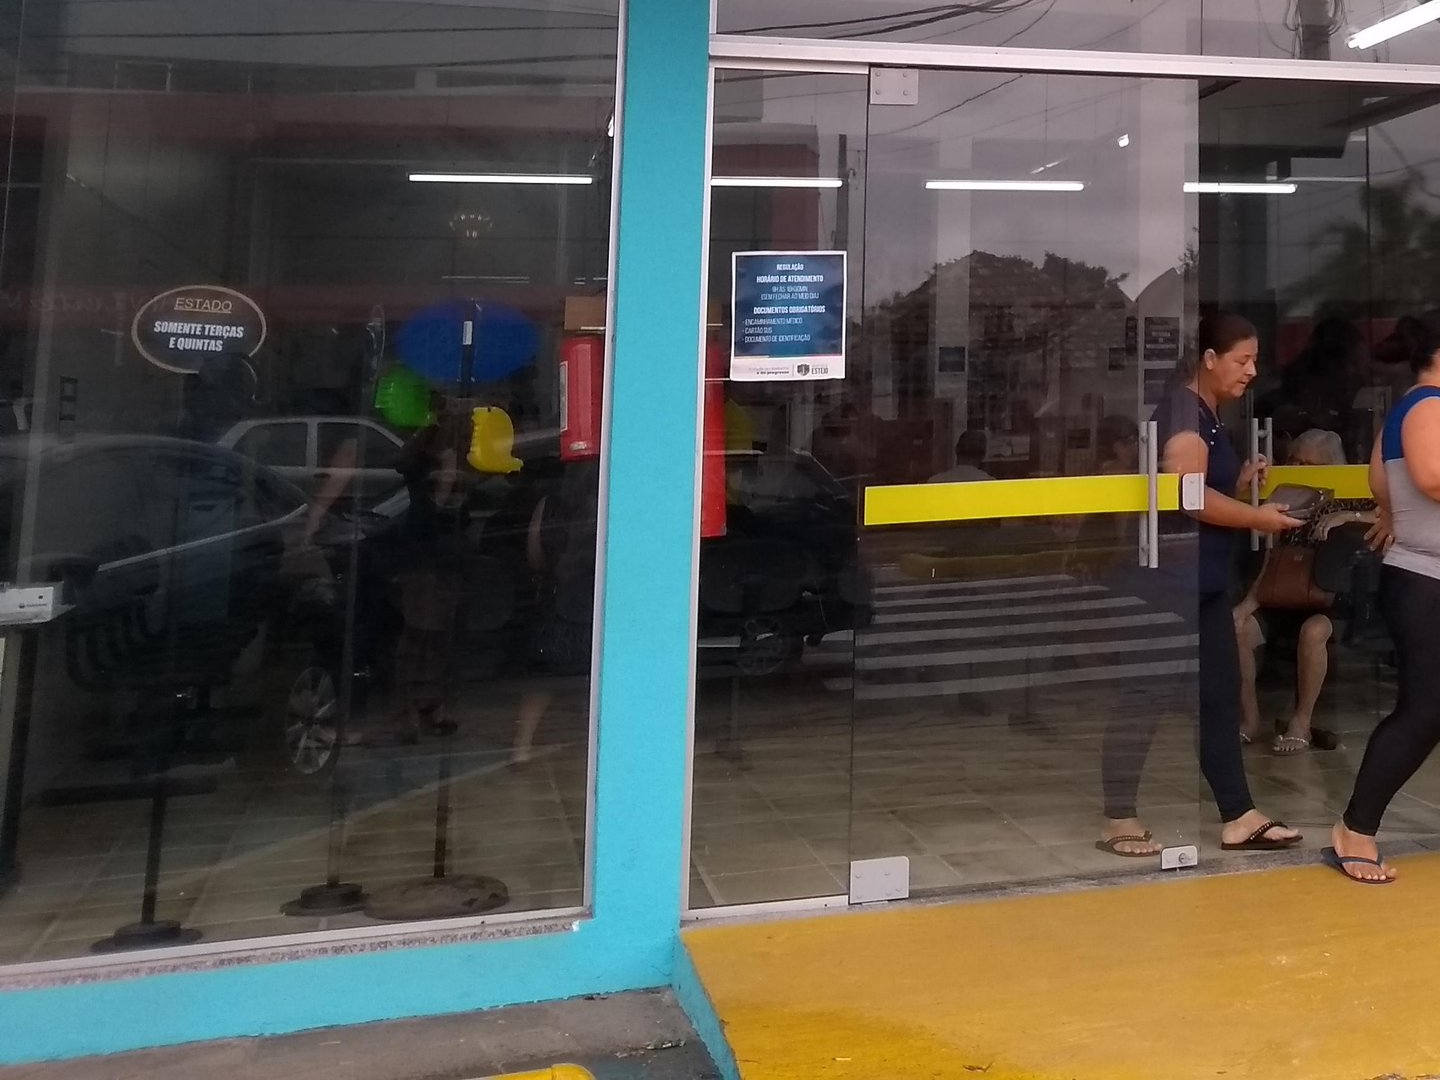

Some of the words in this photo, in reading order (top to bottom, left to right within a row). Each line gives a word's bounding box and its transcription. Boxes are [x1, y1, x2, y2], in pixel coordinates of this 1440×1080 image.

[174, 297, 232, 312] ESTADO
[154, 320, 201, 335] SOMENTE
[204, 324, 244, 339] TERÇAS
[168, 337, 176, 349] E
[176, 338, 223, 351] QUINTAS
[811, 367, 829, 375] ESTEIO
